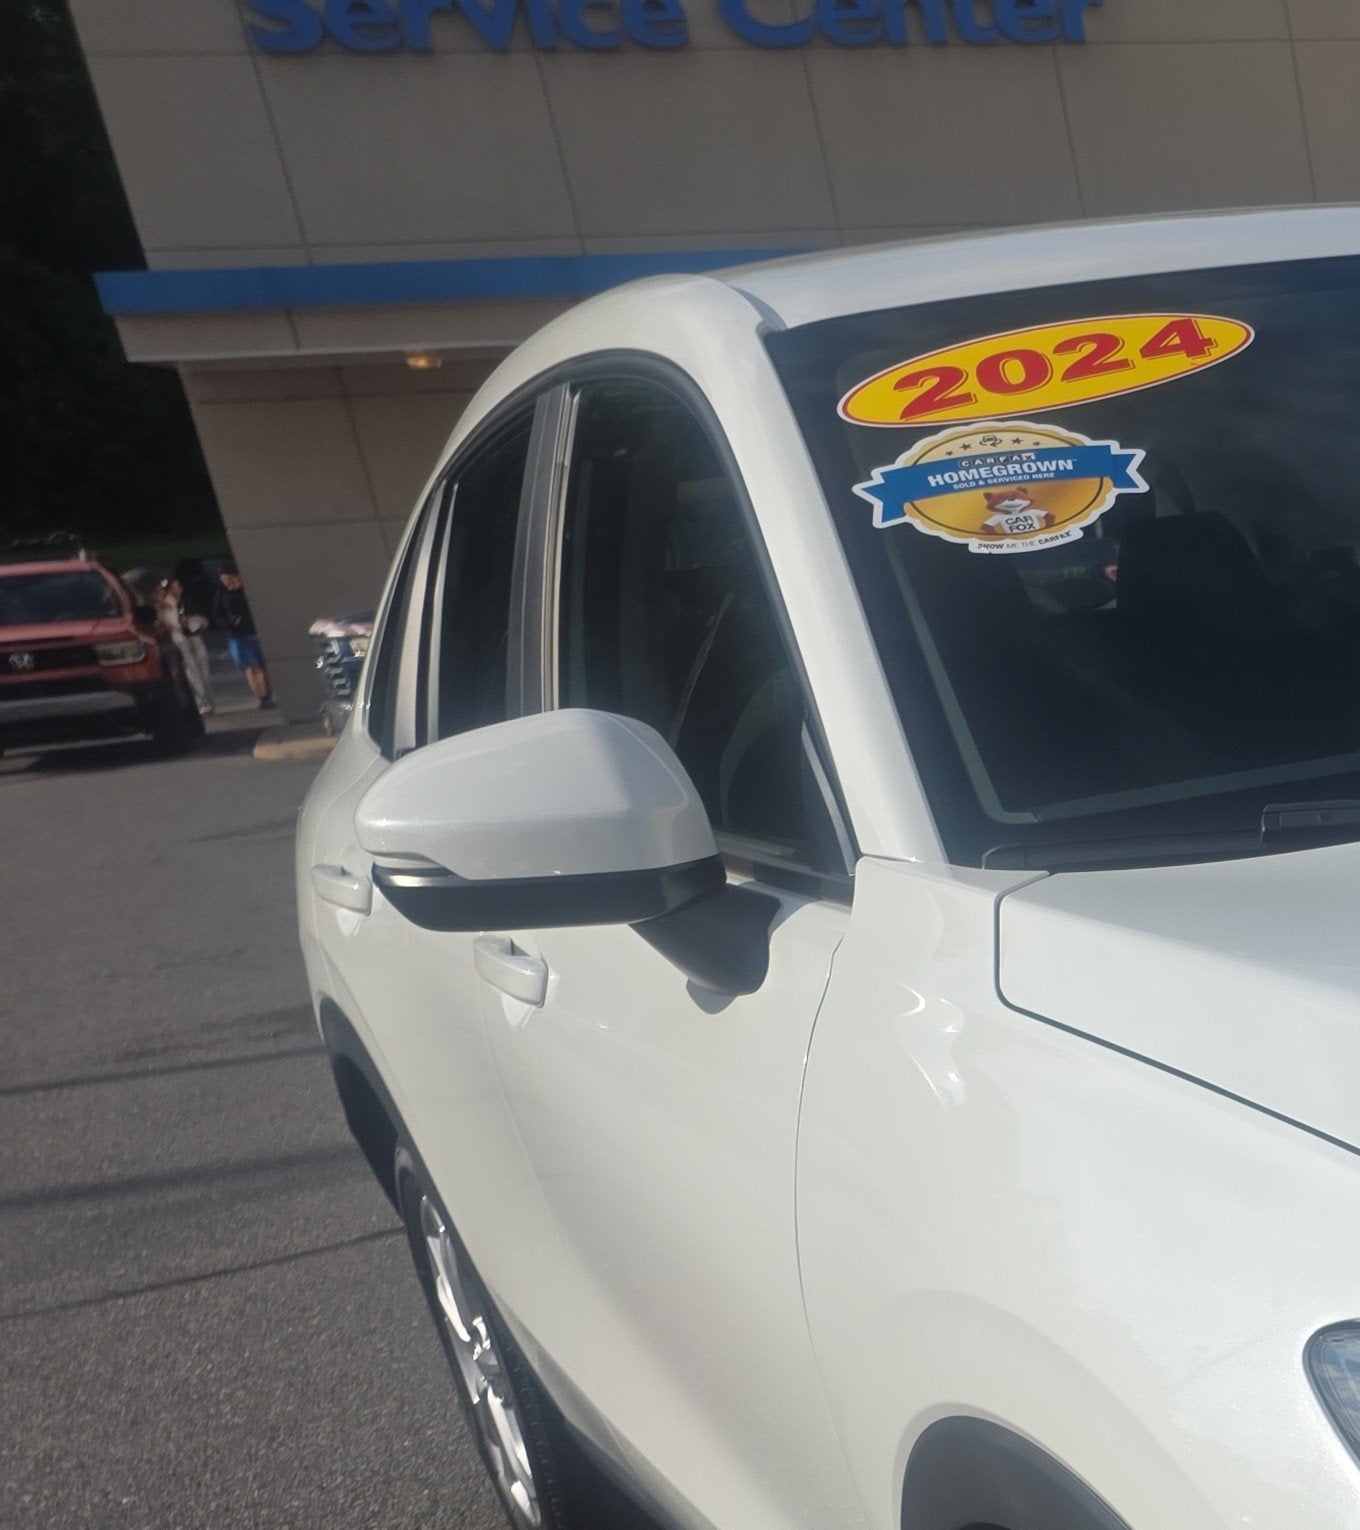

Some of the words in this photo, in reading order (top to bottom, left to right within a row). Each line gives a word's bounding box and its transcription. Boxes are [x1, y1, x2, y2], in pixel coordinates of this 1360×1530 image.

[893, 317, 1218, 420] 2024
[959, 452, 1036, 468] CARFAX
[927, 459, 1074, 487] HOMEGROWN
[953, 480, 976, 490] SOLD
[987, 474, 1030, 485] SERVICED
[1005, 515, 1034, 526] CAR
[1008, 522, 1036, 533] FOX
[1038, 530, 1072, 545] CARFAX
